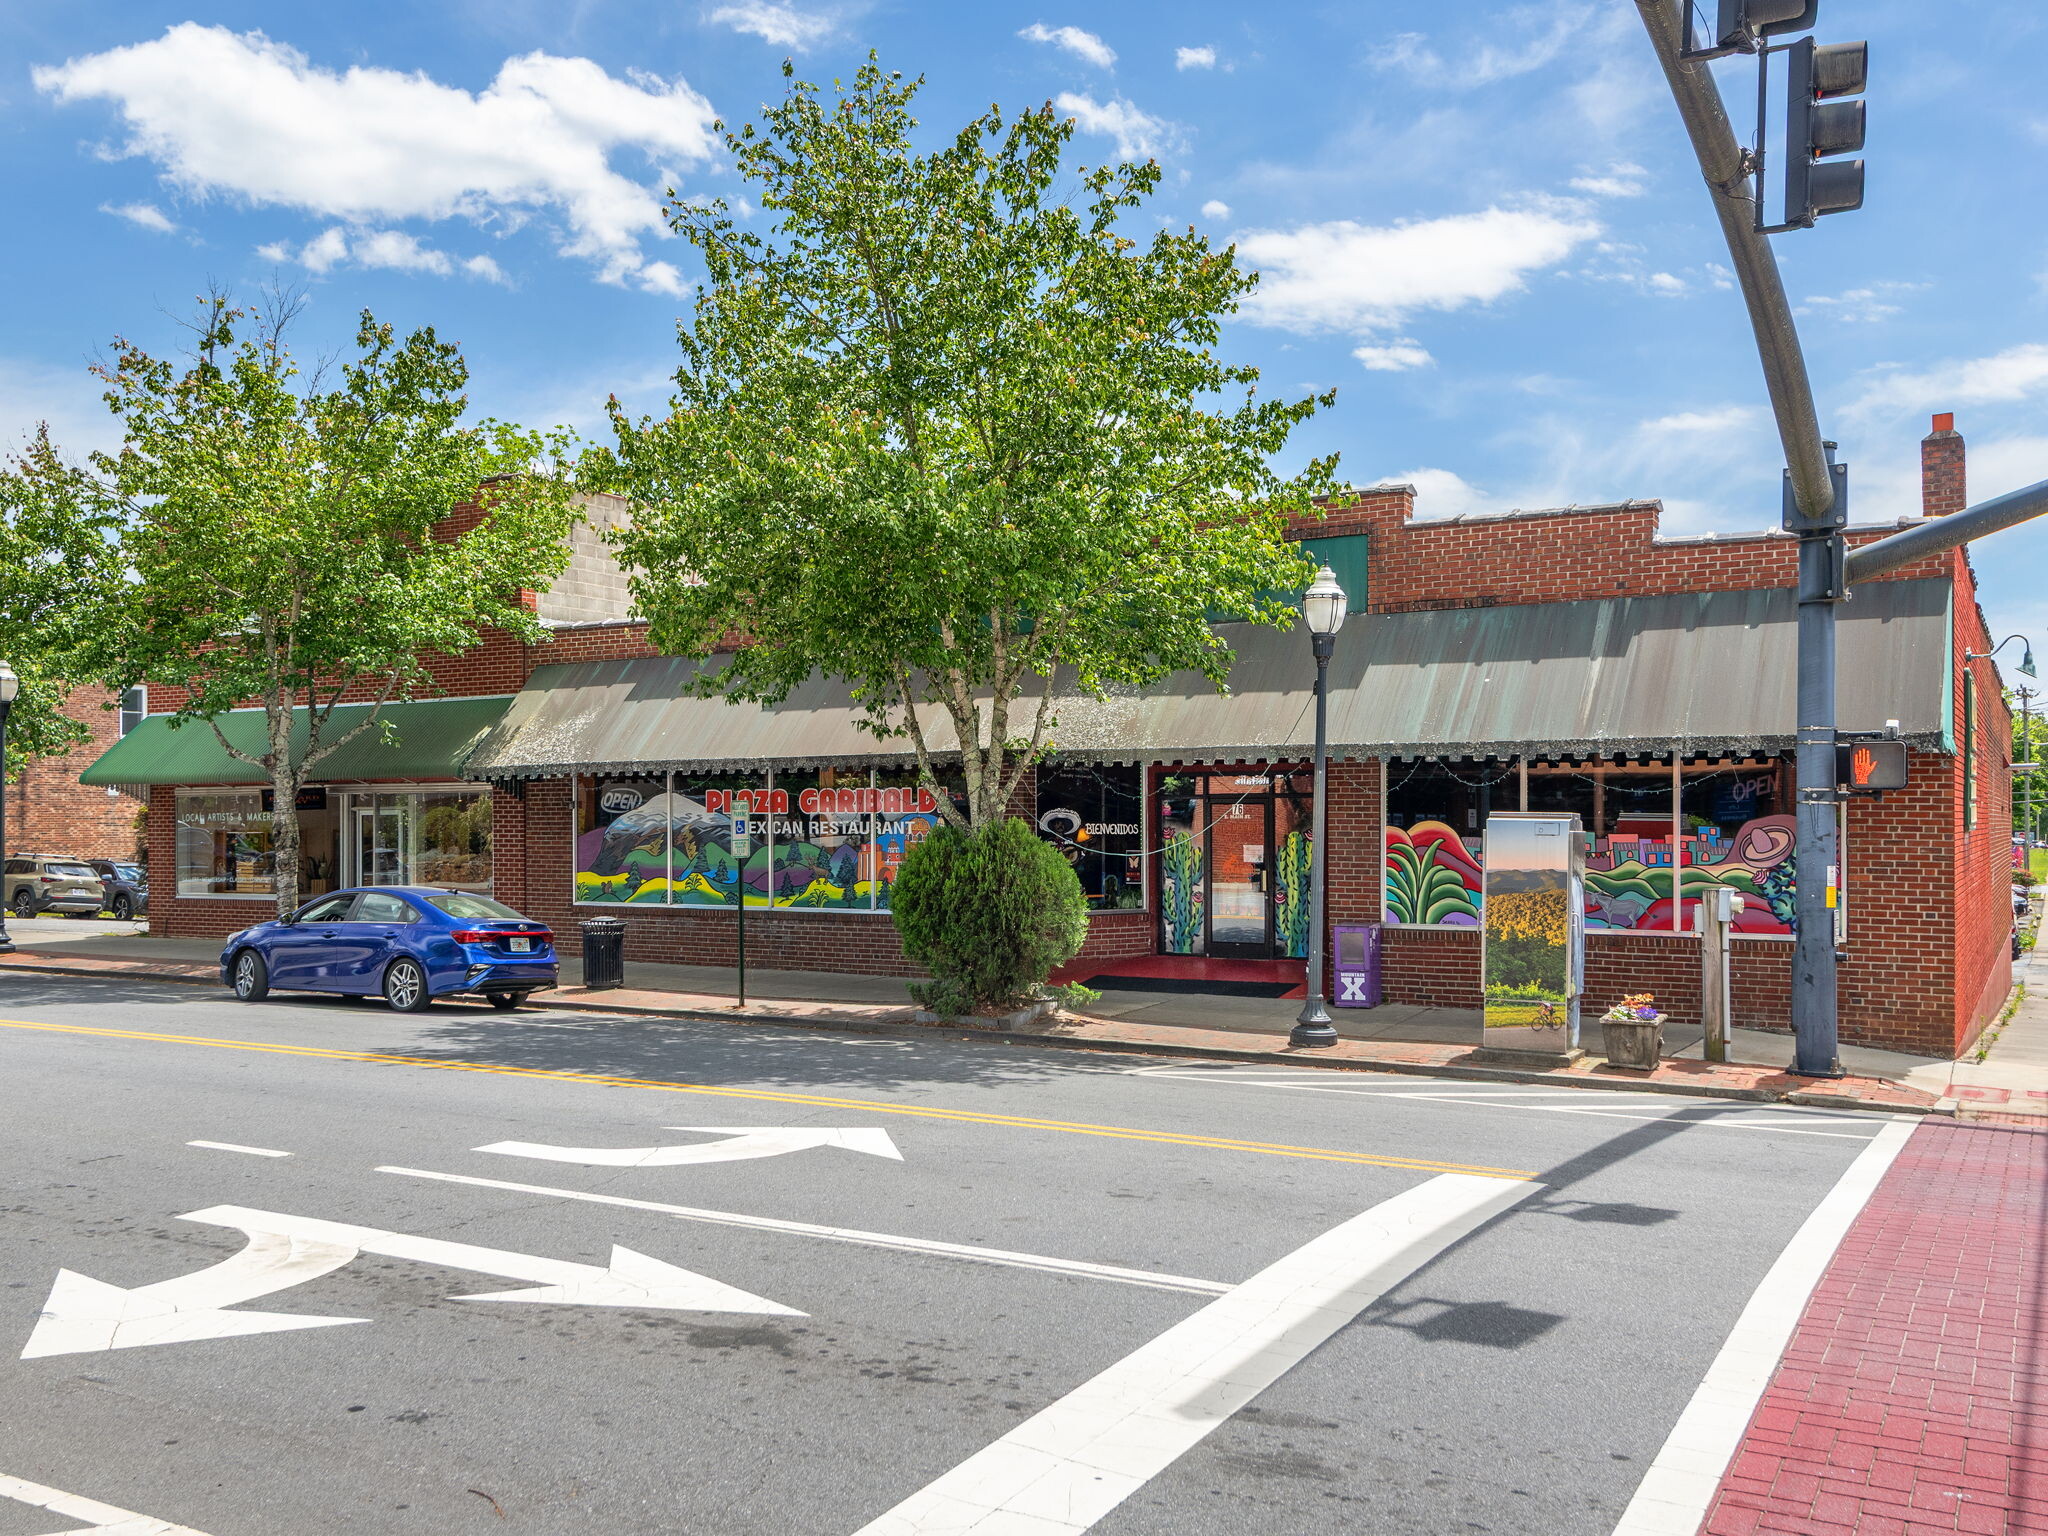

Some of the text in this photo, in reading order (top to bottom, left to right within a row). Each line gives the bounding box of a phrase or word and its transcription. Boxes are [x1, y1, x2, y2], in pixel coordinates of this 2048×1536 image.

[1732, 775, 1779, 801] OPEN
[603, 792, 638, 810] OPEN
[706, 787, 948, 814] PLAZA GARIBALD
[207, 812, 234, 822] ARTISTS
[246, 812, 275, 822] MAKERS
[748, 821, 916, 835] EXICAN RESTAURANT
[1085, 823, 1139, 835] BIENVENIDOS
[1340, 977, 1366, 1000] X
